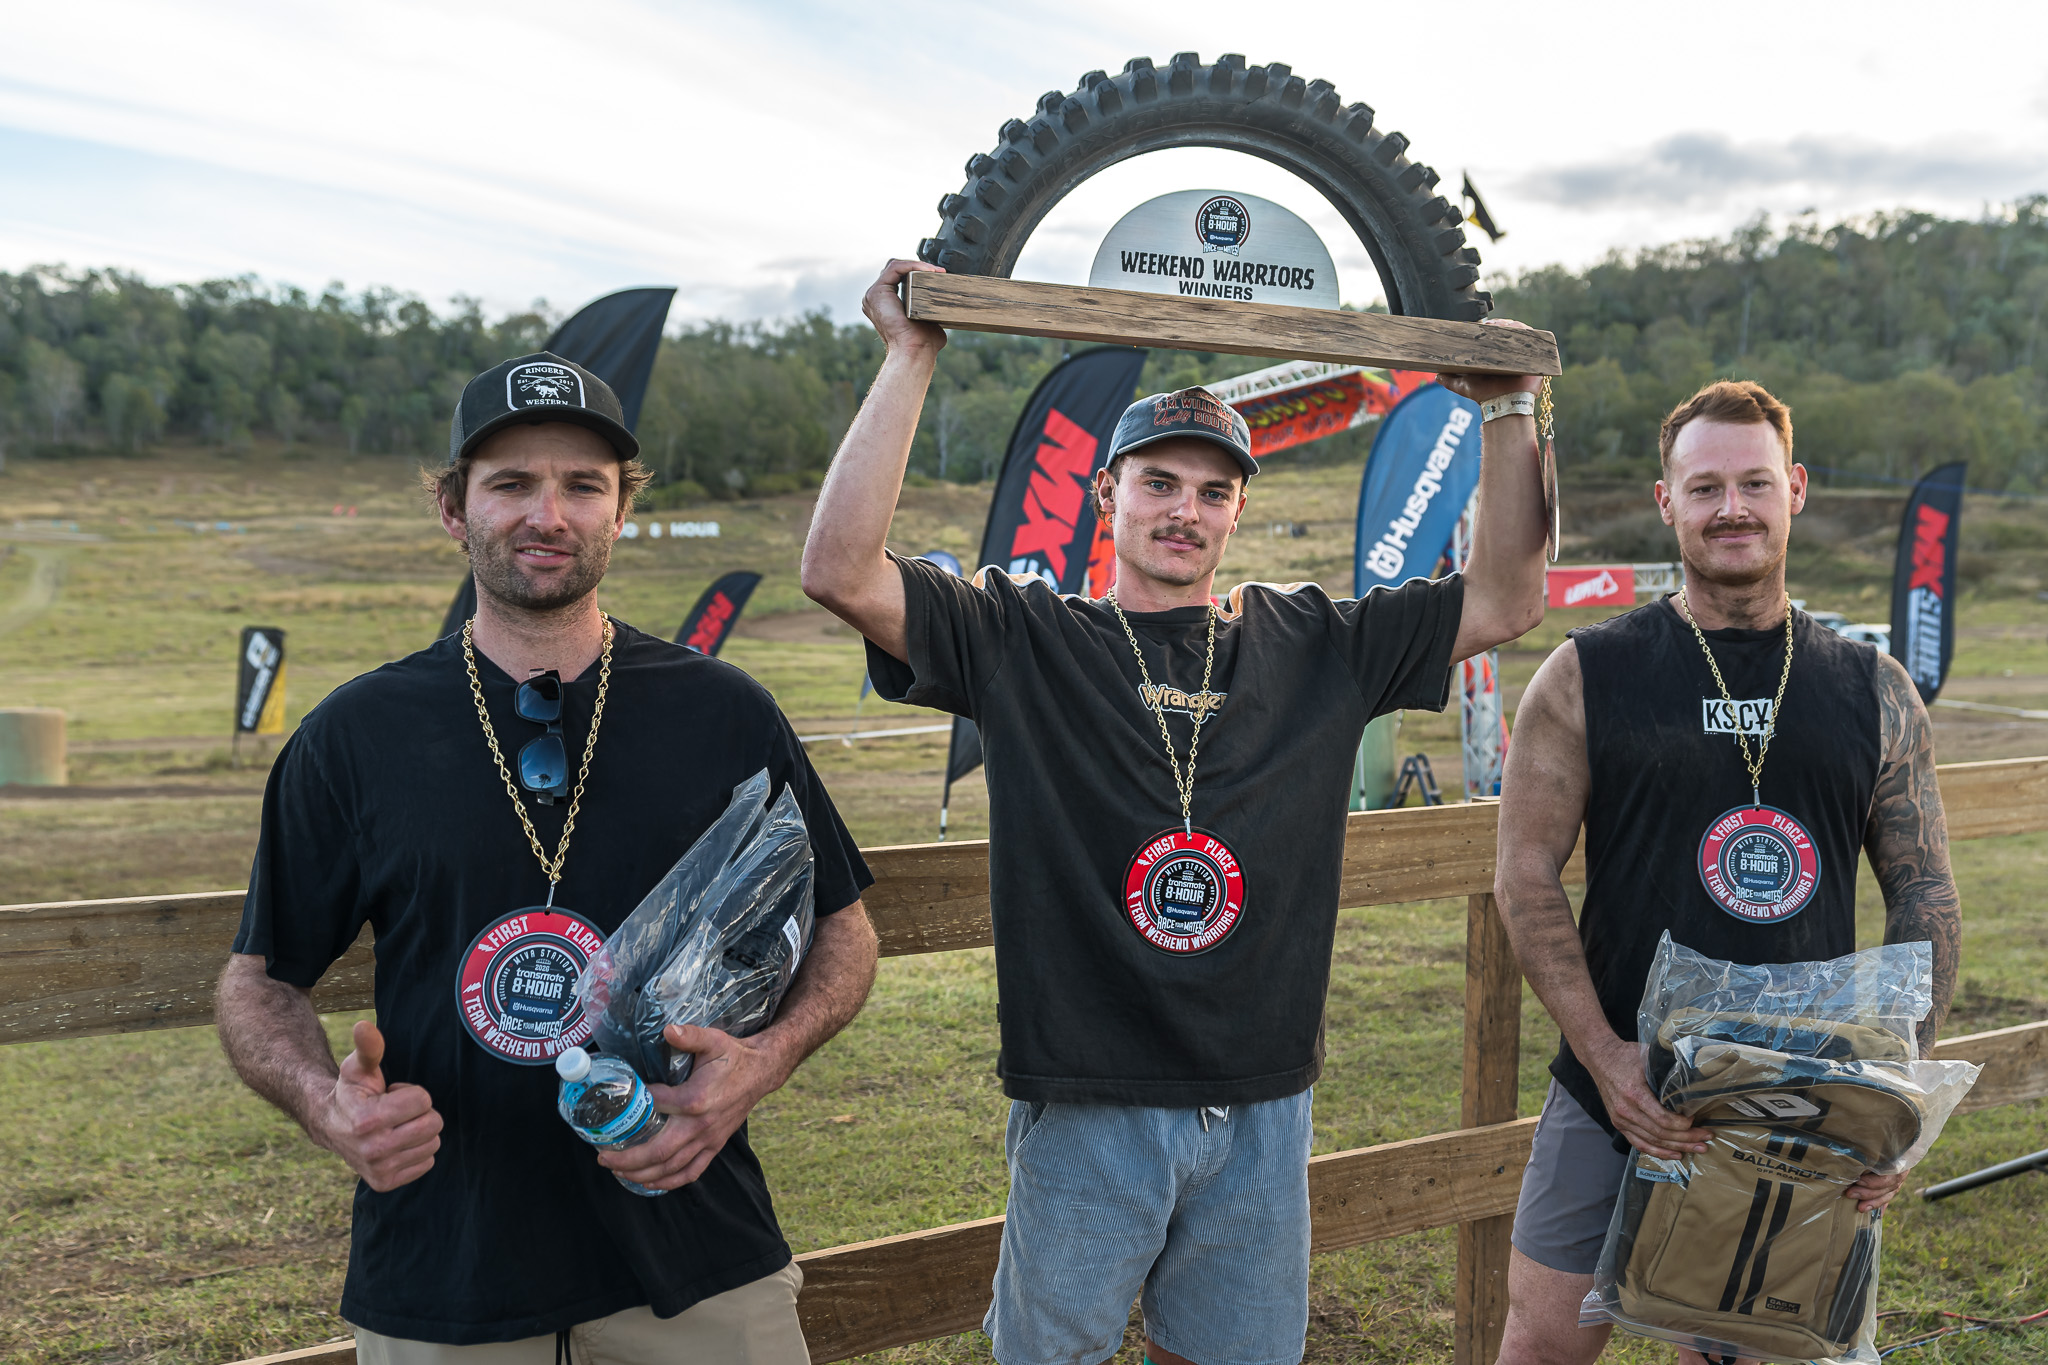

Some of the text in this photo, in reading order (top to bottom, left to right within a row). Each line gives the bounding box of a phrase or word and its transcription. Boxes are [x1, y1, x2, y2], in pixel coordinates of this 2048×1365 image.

[1208, 220, 1237, 232] 8-HOUR
[1120, 250, 1315, 290] WEEKEND WARRIORS
[1179, 281, 1253, 300] WINNERS
[525, 366, 564, 375] RINGERS
[1194, 411, 1232, 436] BOOTS
[1382, 407, 1473, 550] Husqvarna
[670, 521, 720, 538] HOUR
[1715, 812, 1805, 844] FIRST PLACE
[1144, 836, 1236, 872] FIRST PLACE
[1741, 851, 1778, 861] transmoto
[1740, 858, 1778, 874] 8-HOUR
[1168, 878, 1206, 890] transmoto
[1165, 886, 1204, 903] 8-HOUR
[1708, 873, 1812, 918] TEAM WEEKEND WARRIORS
[1736, 886, 1753, 900] RACE
[1762, 888, 1783, 904] MATES!
[1172, 908, 1198, 916] Husqvarna
[1130, 901, 1236, 950] TEAM WEEKEND WARRIORS
[1156, 916, 1176, 930] RACE
[1184, 920, 1206, 936] MATES!
[490, 916, 601, 957] FIRST PLAC
[540, 949, 573, 973] STATION
[516, 968, 565, 982] transmoto
[512, 978, 562, 998] 8-HOUR
[520, 1004, 553, 1014] Husqvarna
[465, 995, 592, 1058] TEAM WEEKEND WARRIO
[499, 1013, 523, 1032] RACE
[534, 1020, 564, 1040] MATES!
[605, 1099, 642, 1136] SPRING WATER
[1776, 1172, 1800, 1180] ROAD
